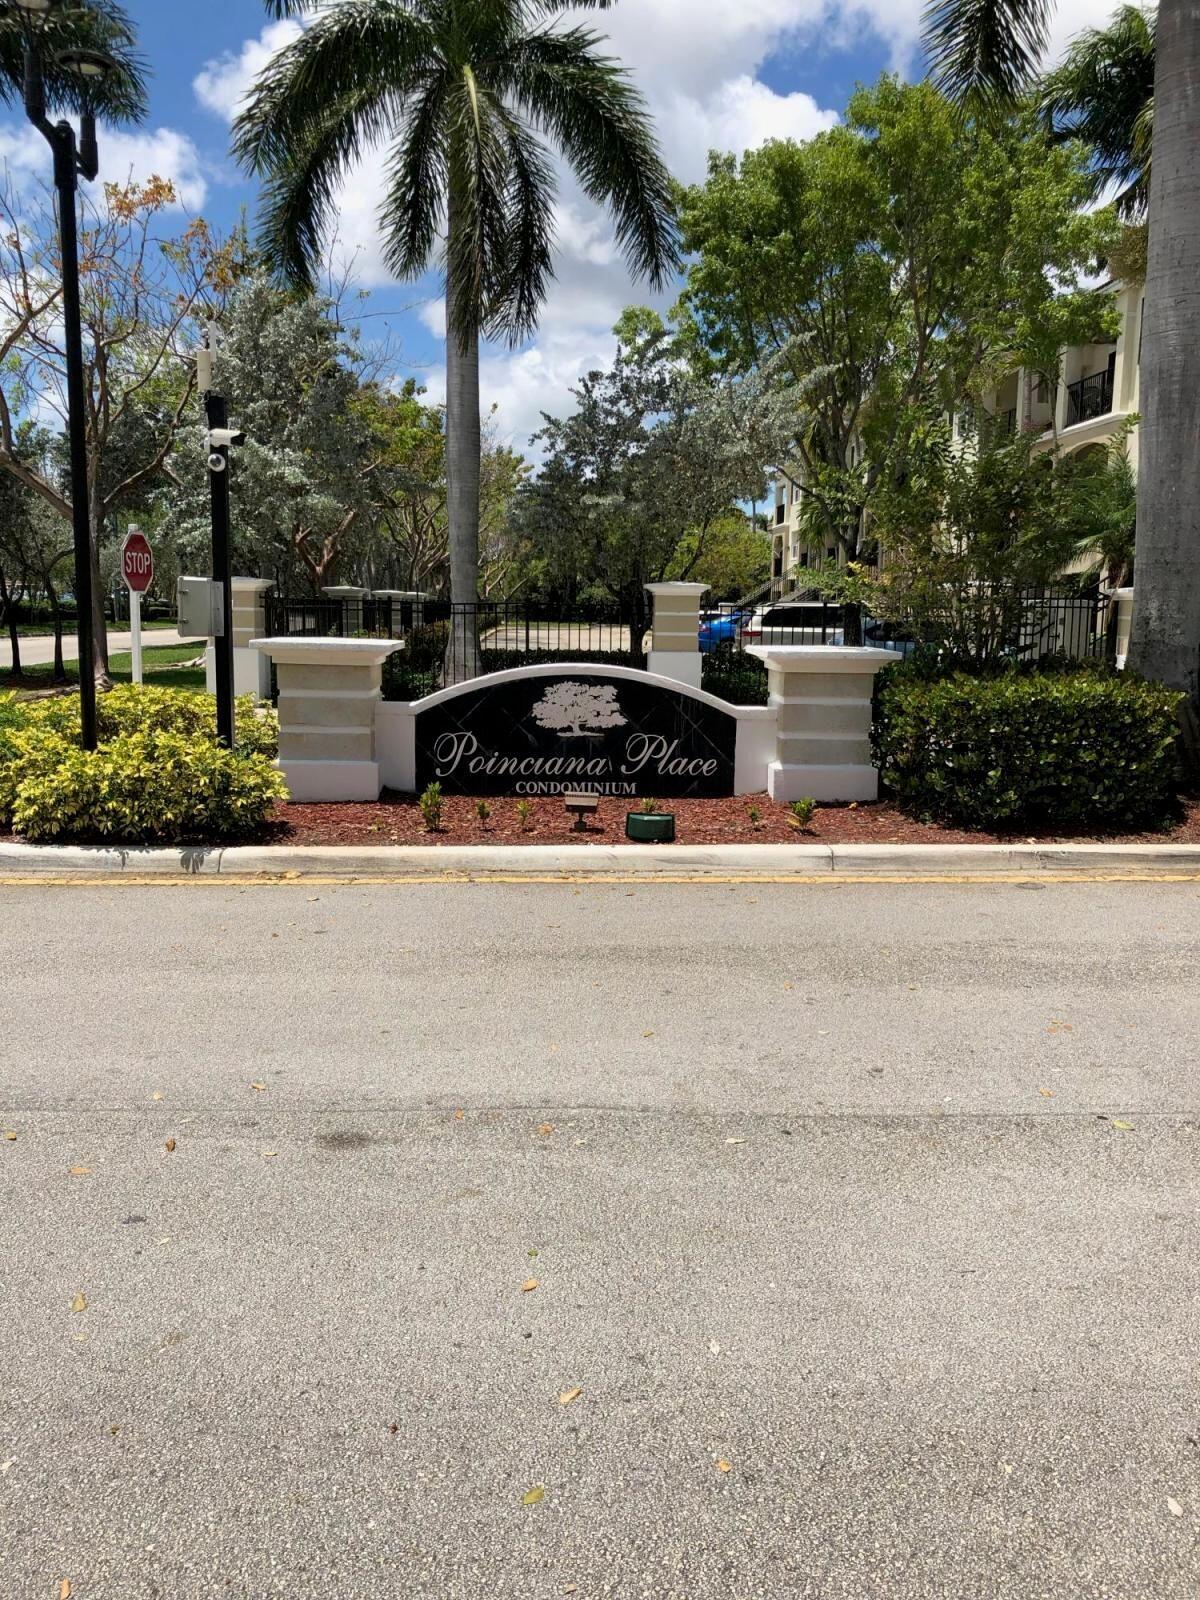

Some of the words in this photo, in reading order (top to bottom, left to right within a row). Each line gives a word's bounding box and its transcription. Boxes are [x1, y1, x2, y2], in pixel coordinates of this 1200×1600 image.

[125, 551, 151, 574] STOP
[433, 731, 608, 777] Poinciana
[620, 732, 718, 777] Place
[515, 780, 637, 795] CONDOMINIUM
